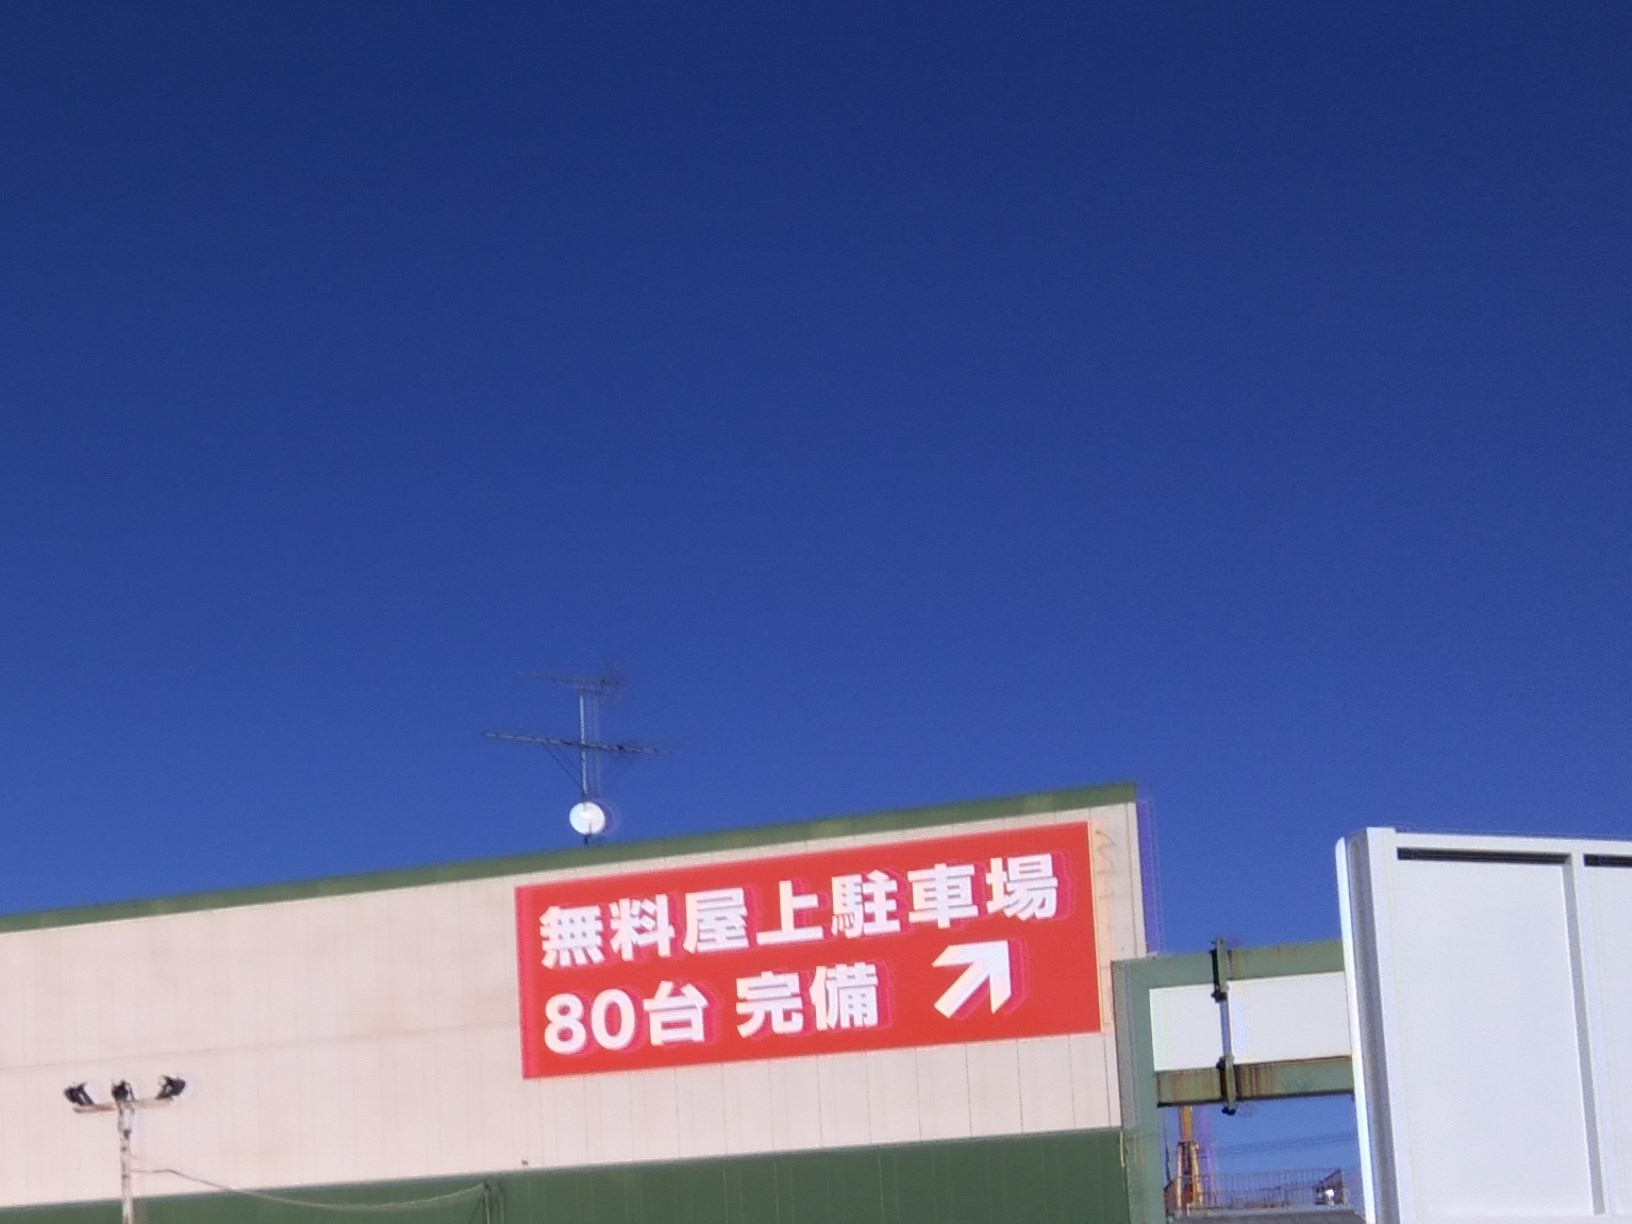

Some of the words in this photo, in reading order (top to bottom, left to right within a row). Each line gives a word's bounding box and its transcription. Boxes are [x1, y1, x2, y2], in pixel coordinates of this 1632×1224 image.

[539, 853, 1059, 968] 無料屋上駐車場
